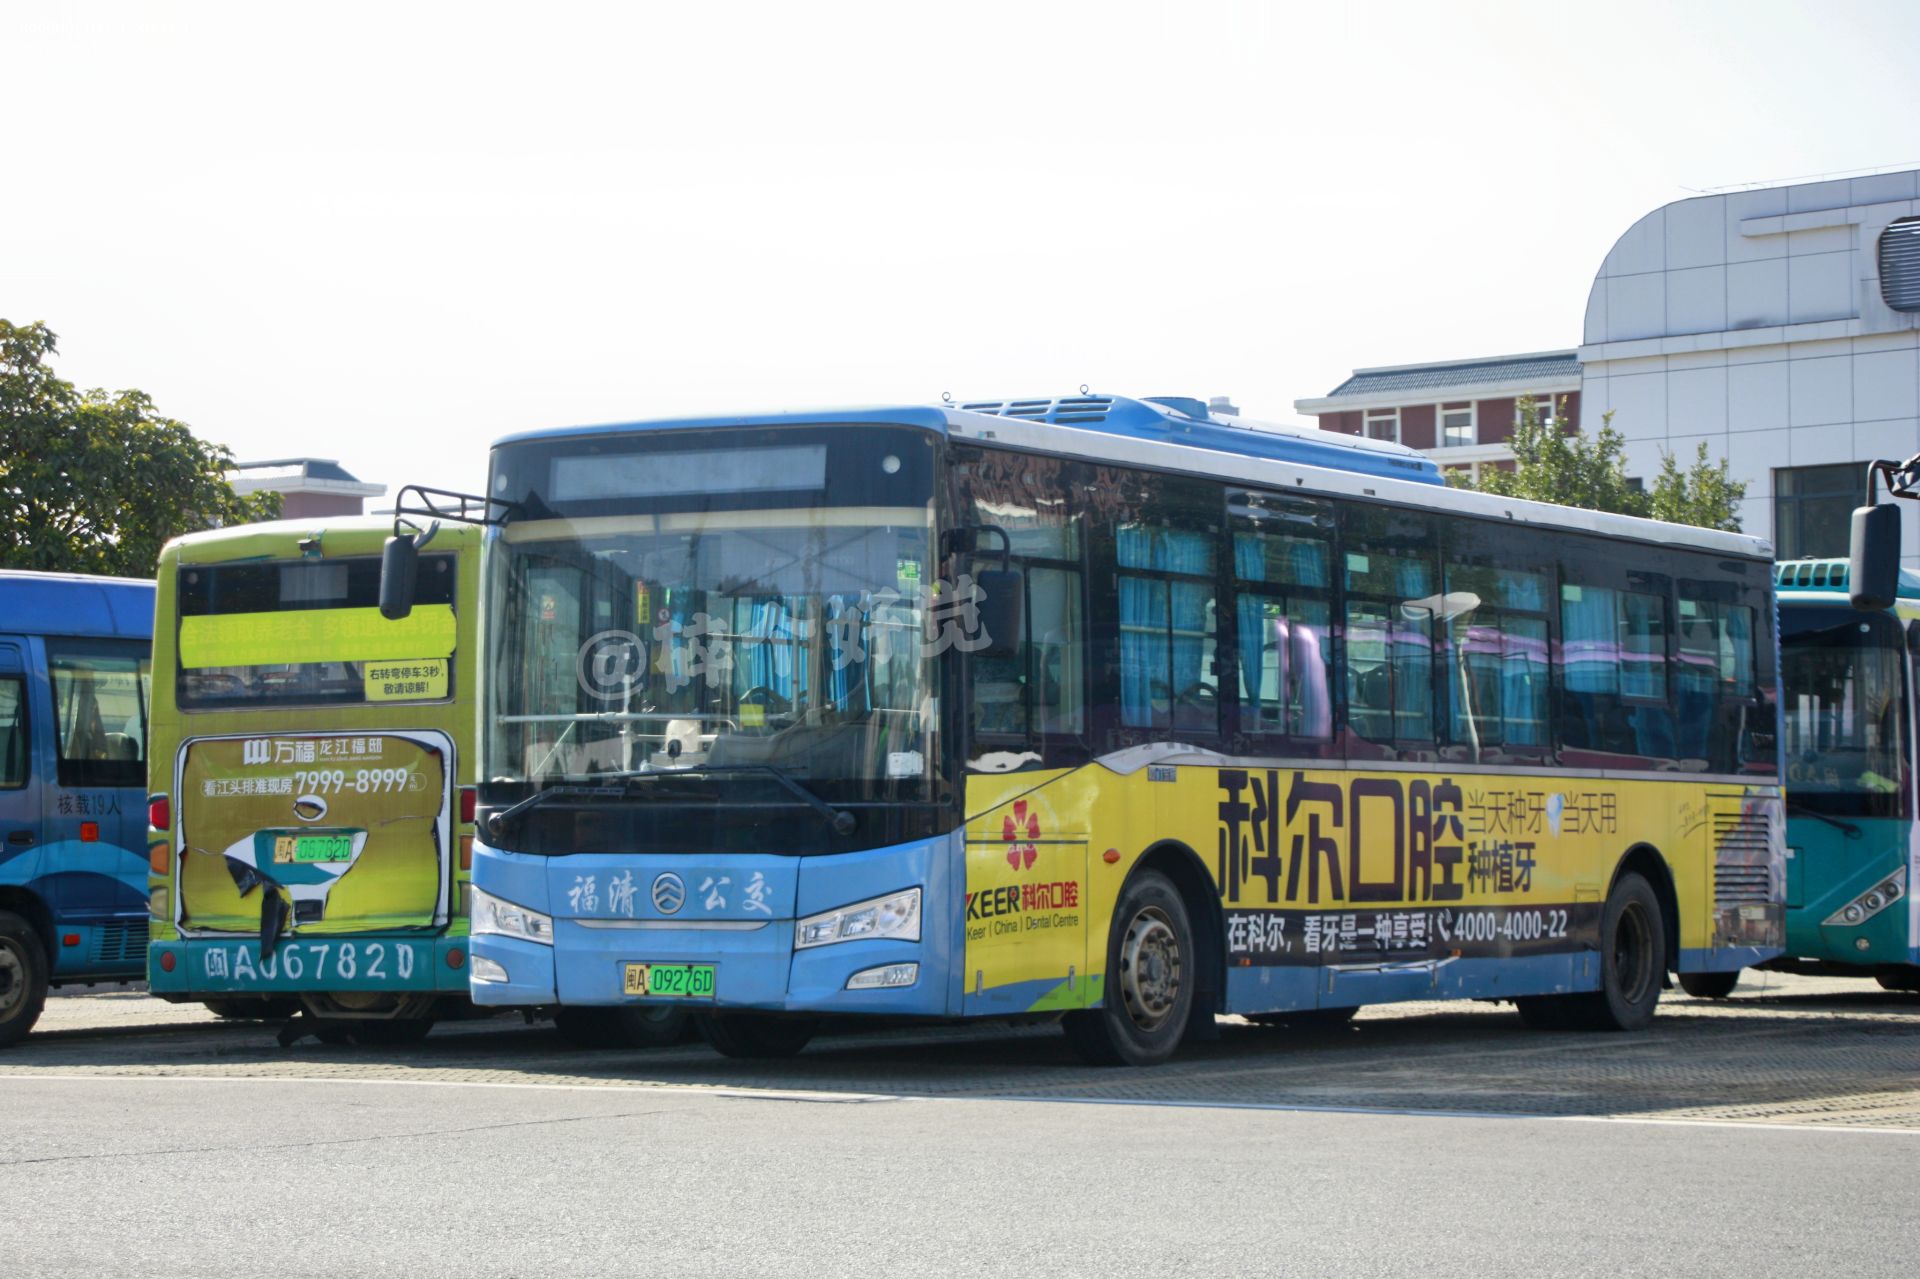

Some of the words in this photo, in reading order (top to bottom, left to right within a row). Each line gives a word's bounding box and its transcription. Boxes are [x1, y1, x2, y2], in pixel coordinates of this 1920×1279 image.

[274, 741, 315, 763] 万福
[320, 738, 383, 755] 龙江福邸
[295, 768, 408, 794] 7999-8999
[57, 794, 122, 815] 核载19人
[1468, 789, 1545, 834] 当天种牙
[1563, 790, 1617, 834] 当天用
[1218, 769, 1464, 904] 科尔口腔
[1467, 840, 1536, 894] 种植牙
[568, 870, 638, 917] 福清
[699, 871, 772, 916] 公交
[966, 885, 1020, 921] KEER
[1022, 881, 1079, 911] 科尔口腔
[967, 926, 986, 941] Keer
[1026, 914, 1050, 930] Dental
[1054, 914, 1079, 928] Centre
[1454, 910, 1567, 942] 4000-4000-22
